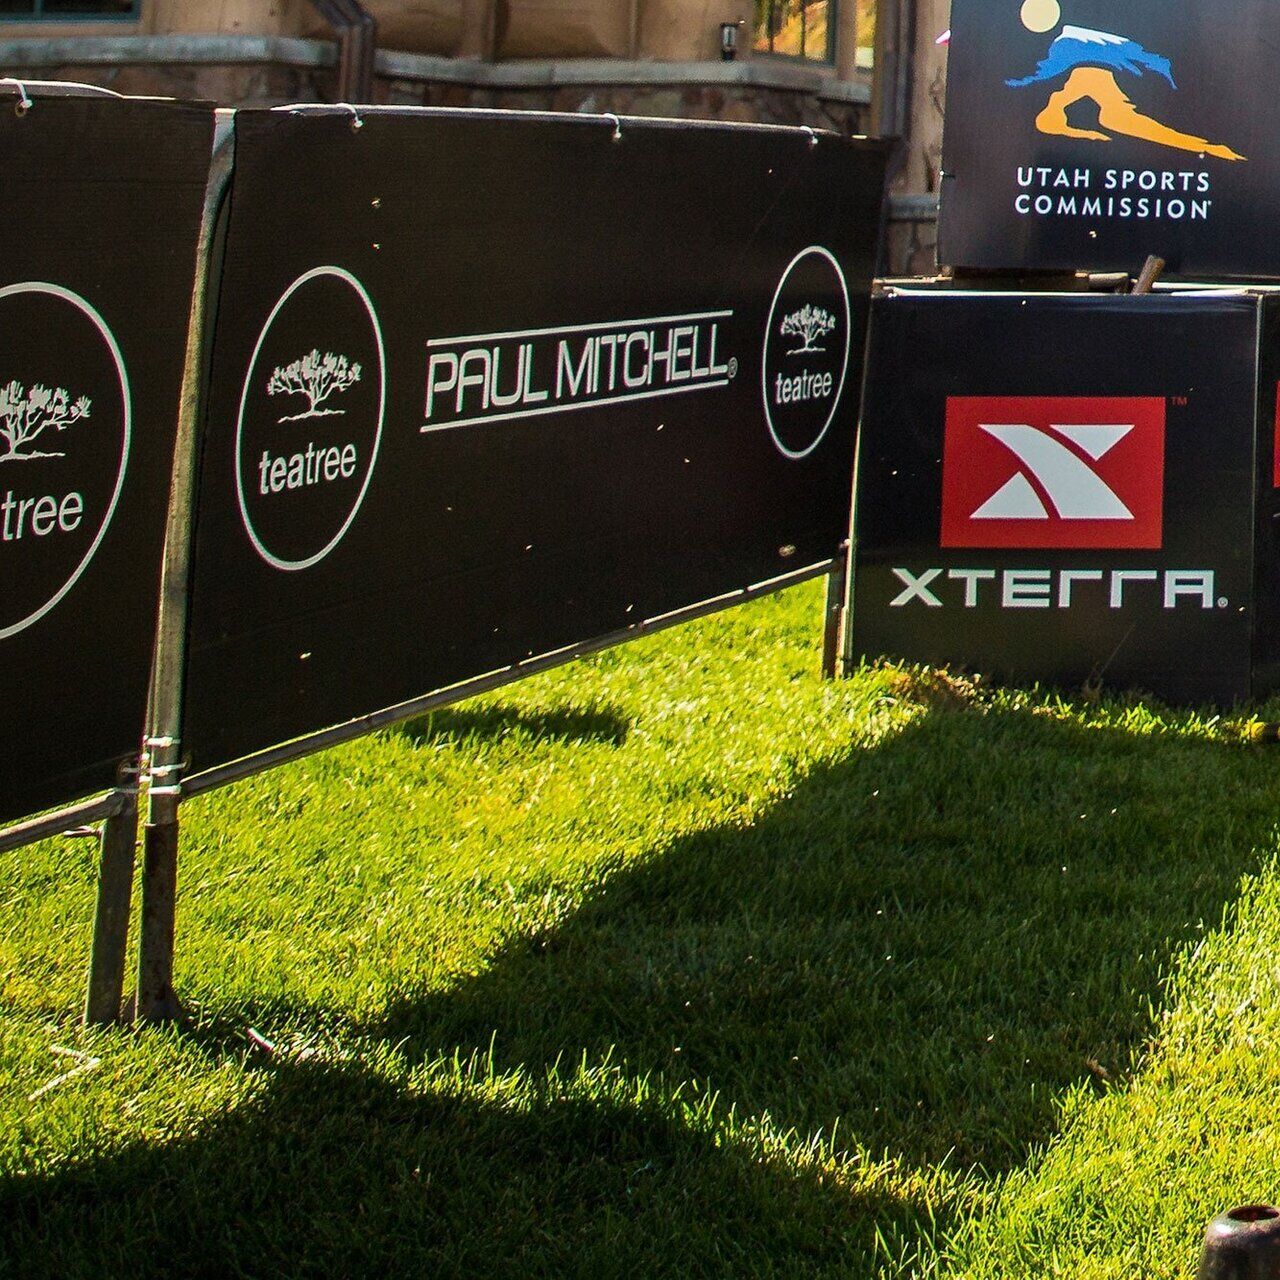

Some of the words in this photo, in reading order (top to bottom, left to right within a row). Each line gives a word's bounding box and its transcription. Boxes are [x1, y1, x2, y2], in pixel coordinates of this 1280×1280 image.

[1017, 167, 1090, 189] UTAH
[1104, 169, 1211, 192] SPORTS
[1014, 194, 1208, 220] COMMISSION
[425, 343, 548, 418] PAUL
[555, 324, 728, 399] MITCHELL
[773, 369, 833, 406] teatree
[258, 442, 357, 495] teatree
[1, 490, 84, 541] tree
[888, 567, 1215, 608] XTERRA
